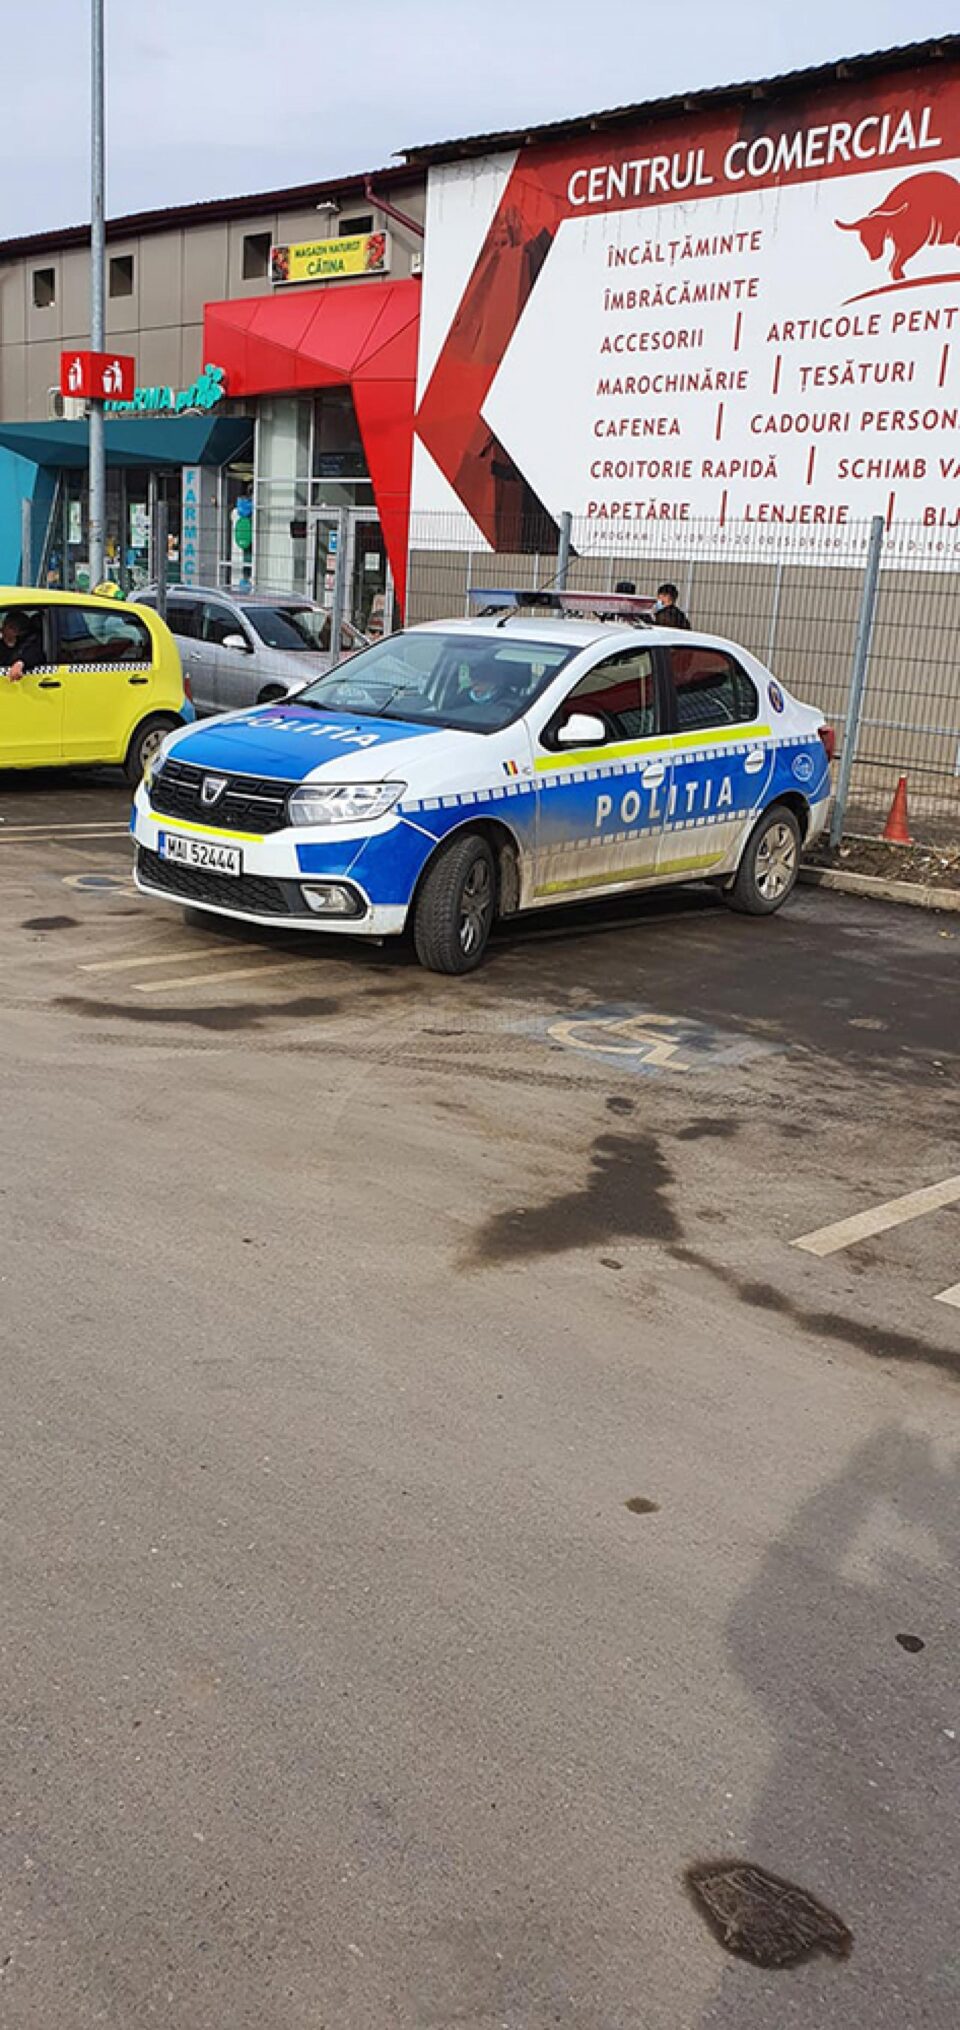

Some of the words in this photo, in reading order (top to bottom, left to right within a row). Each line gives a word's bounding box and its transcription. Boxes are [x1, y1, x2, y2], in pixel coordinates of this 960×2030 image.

[567, 149, 713, 206] CENTRUL
[723, 106, 942, 181] COMERCIAL
[607, 230, 762, 268] ÎNCĂLȚĂMINTE
[604, 277, 760, 311] ÎMBRĂCĂMINTE
[600, 328, 704, 354] ACCESORII
[766, 314, 881, 342] ARTICOLE
[596, 367, 749, 396] MAROCHINĂRIE
[799, 359, 915, 392] ȚESĂTURI
[593, 418, 681, 437] CAFENEA
[750, 412, 850, 434] CADOURI
[860, 408, 960, 431] PERSON
[590, 460, 693, 479] CROITORIE
[701, 454, 778, 479] RAPIDĂ
[837, 458, 927, 479] SCHIMB
[587, 498, 690, 521] PAPETĂRIE
[744, 503, 850, 525] LENJERIE
[168, 837, 187, 859] MAI
[191, 843, 235, 871] 52444
